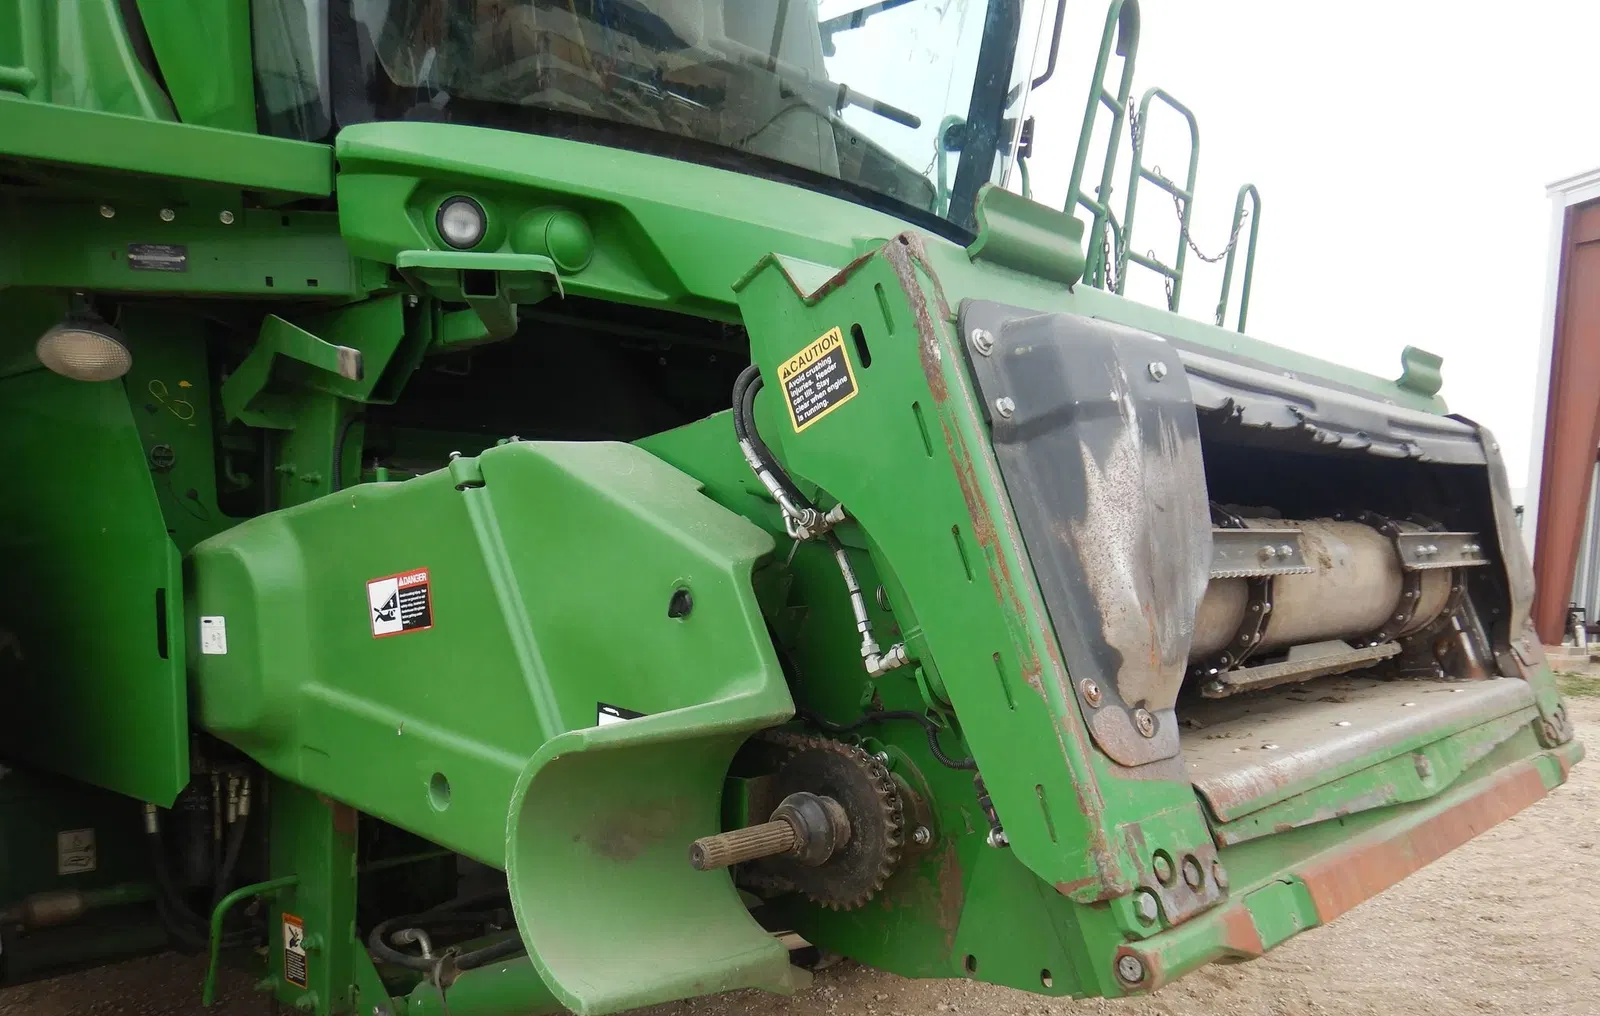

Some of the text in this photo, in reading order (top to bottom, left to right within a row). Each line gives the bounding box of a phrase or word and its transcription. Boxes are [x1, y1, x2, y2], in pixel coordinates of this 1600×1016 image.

[790, 332, 839, 373] CAUTION
[788, 356, 832, 389] Avoid crushing
[790, 362, 837, 397] injuries. Header
[793, 395, 804, 406] can
[815, 377, 830, 390] Stay
[795, 375, 848, 414] clear when engine
[797, 399, 829, 422] is running.
[403, 572, 427, 584] DANGER
